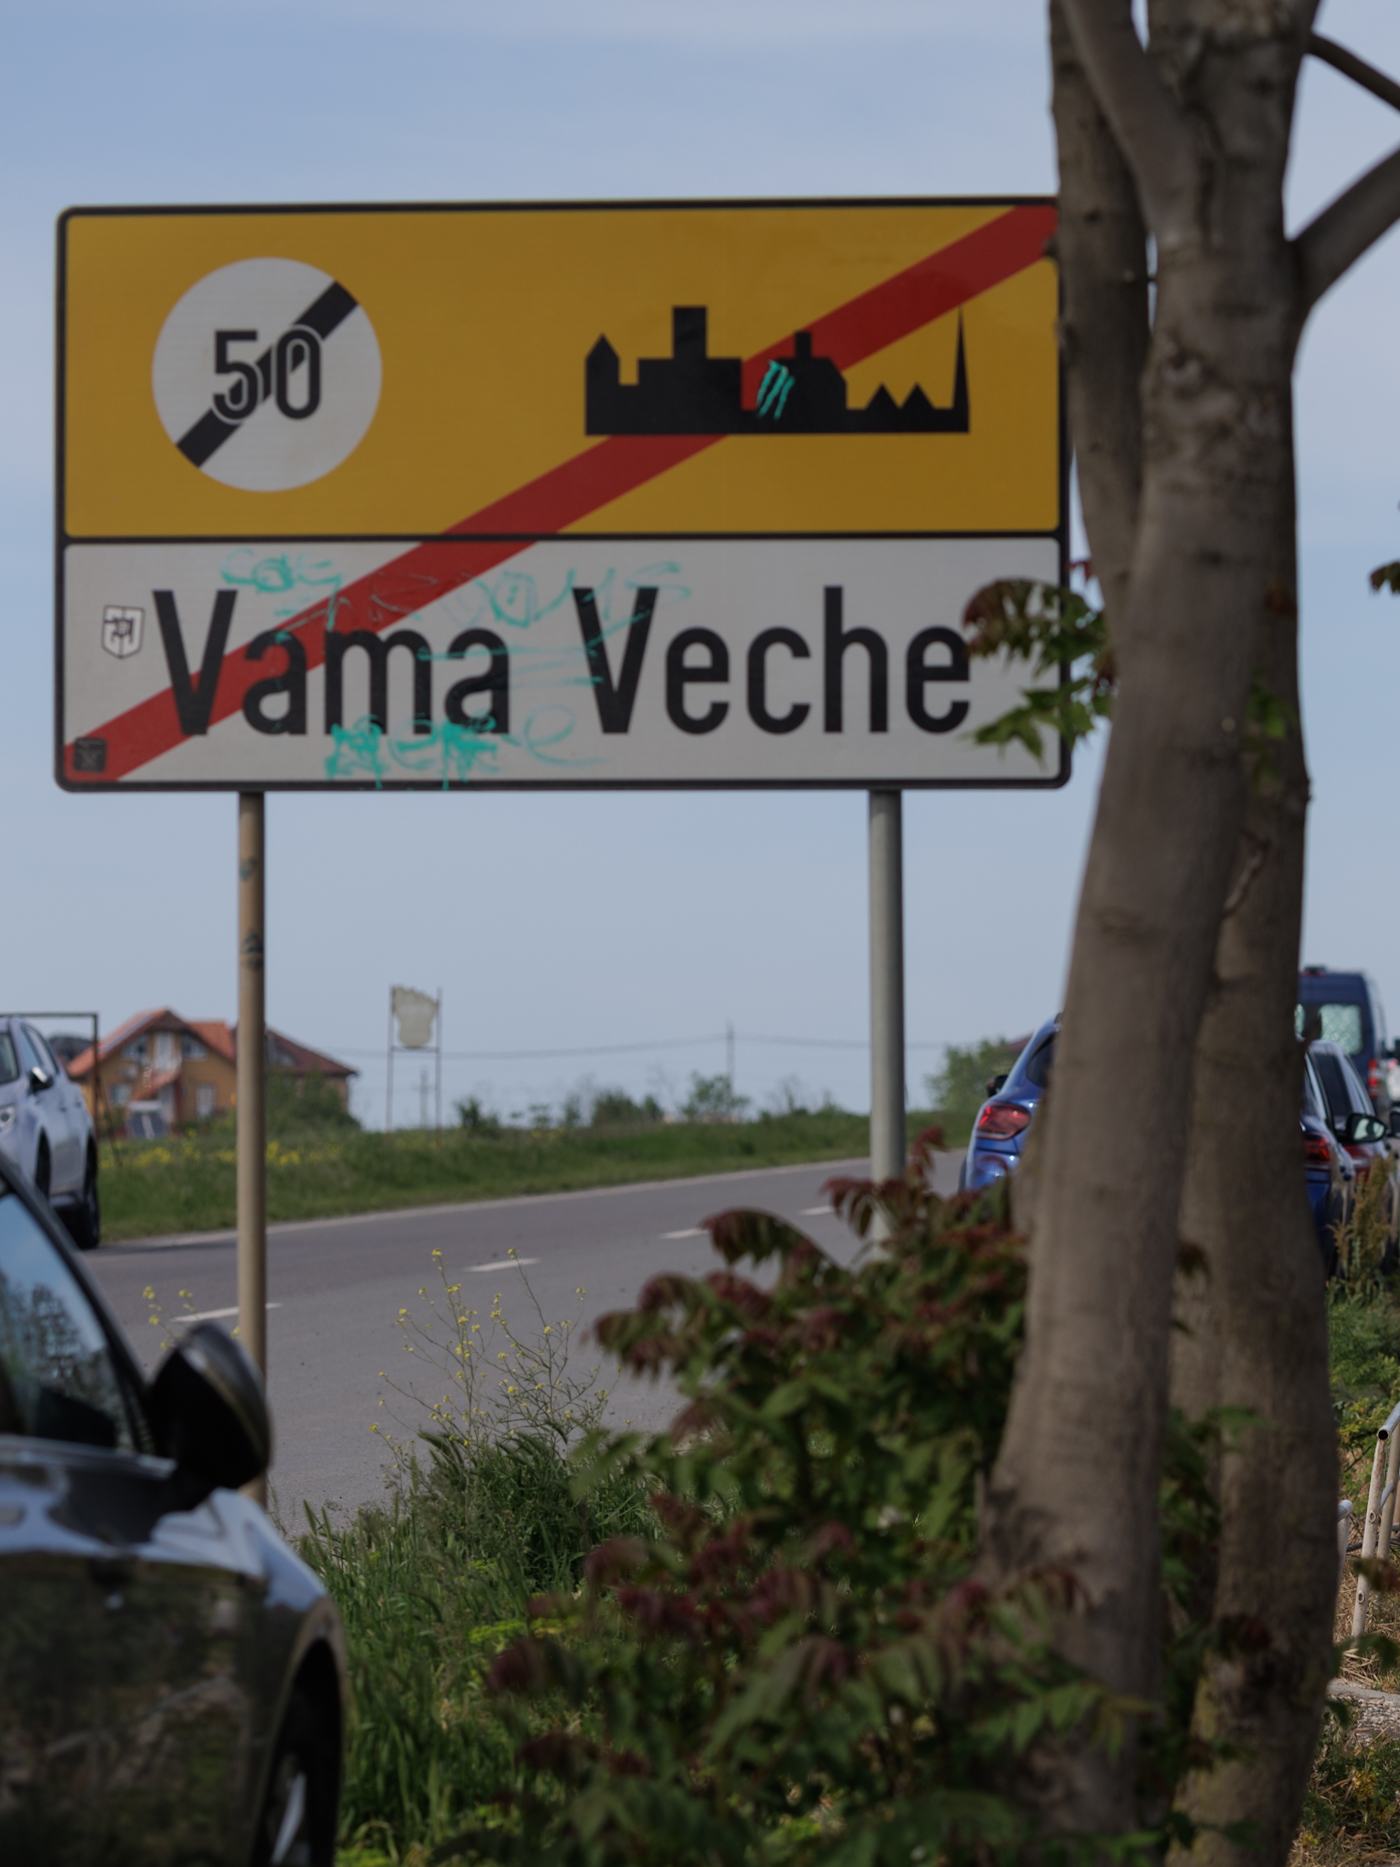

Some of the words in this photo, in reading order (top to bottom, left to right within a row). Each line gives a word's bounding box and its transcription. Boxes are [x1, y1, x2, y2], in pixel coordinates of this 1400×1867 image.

[213, 329, 321, 420] 50
[152, 588, 511, 736] Vama
[572, 585, 971, 735] Veche
